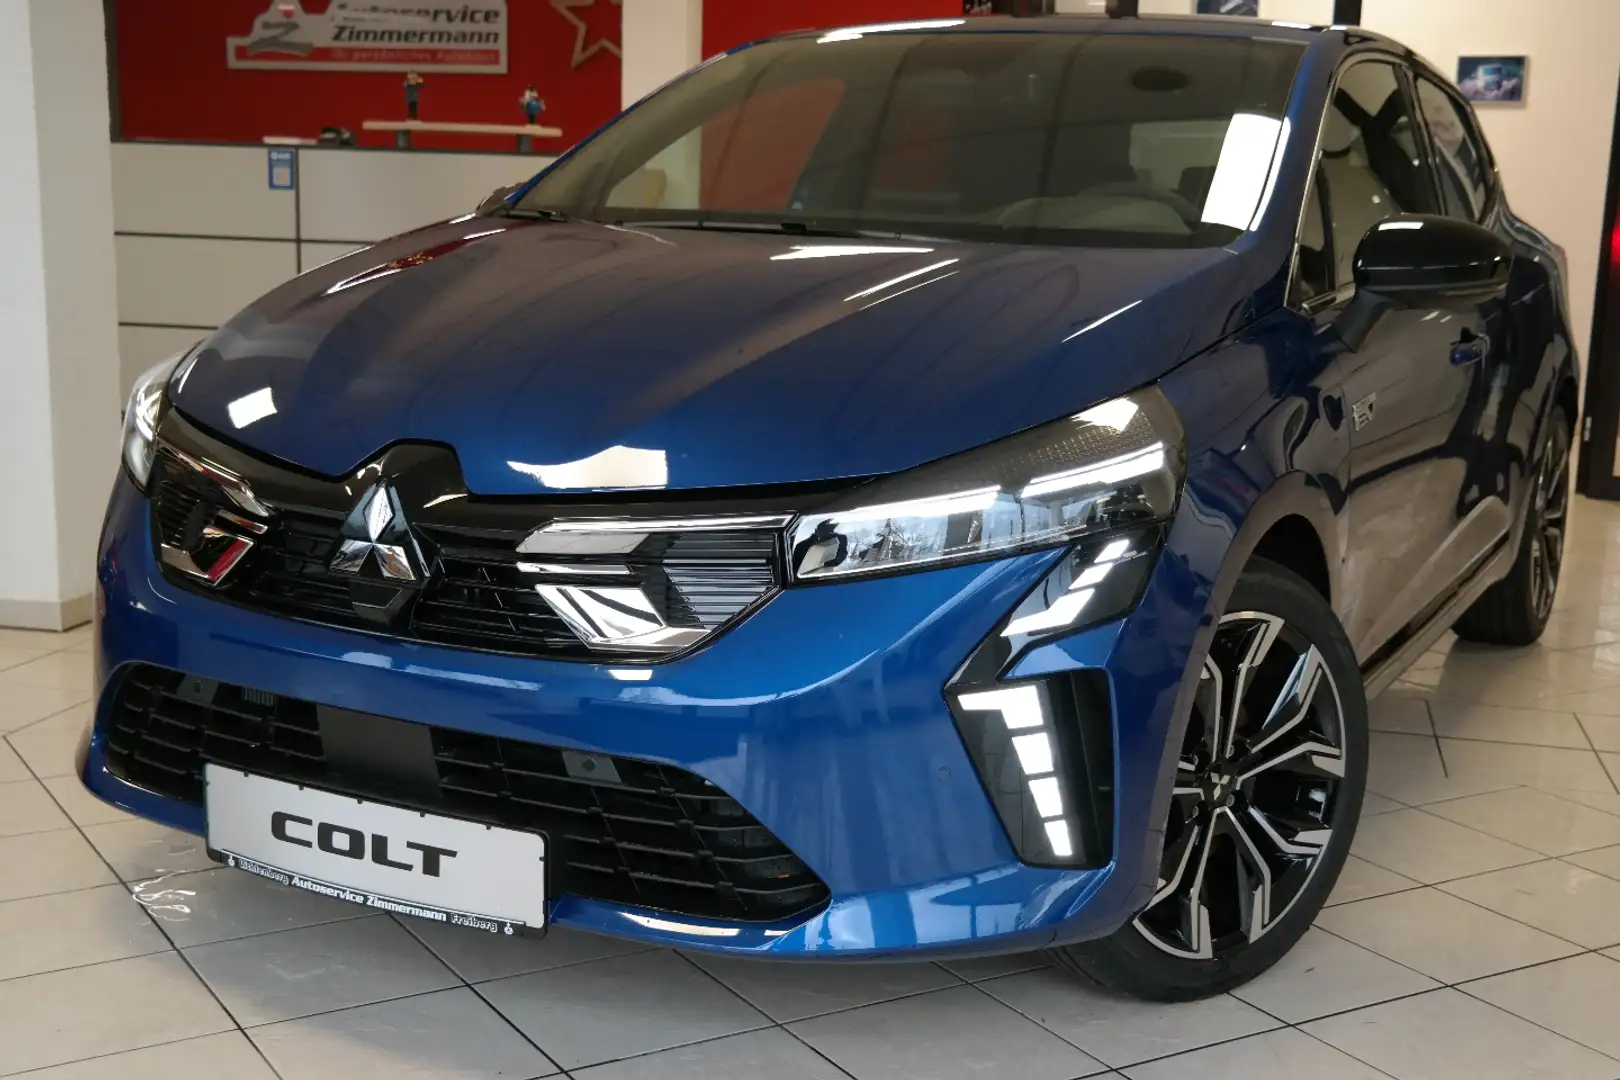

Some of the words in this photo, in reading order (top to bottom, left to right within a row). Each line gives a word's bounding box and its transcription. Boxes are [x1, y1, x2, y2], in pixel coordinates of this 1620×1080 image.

[333, 3, 500, 24] ervice
[331, 25, 500, 44] Zimmermann
[271, 811, 457, 878] COLT
[291, 877, 364, 903] Autoservice
[366, 895, 447, 922] Zimmermann
[451, 912, 498, 933] Freiberg
